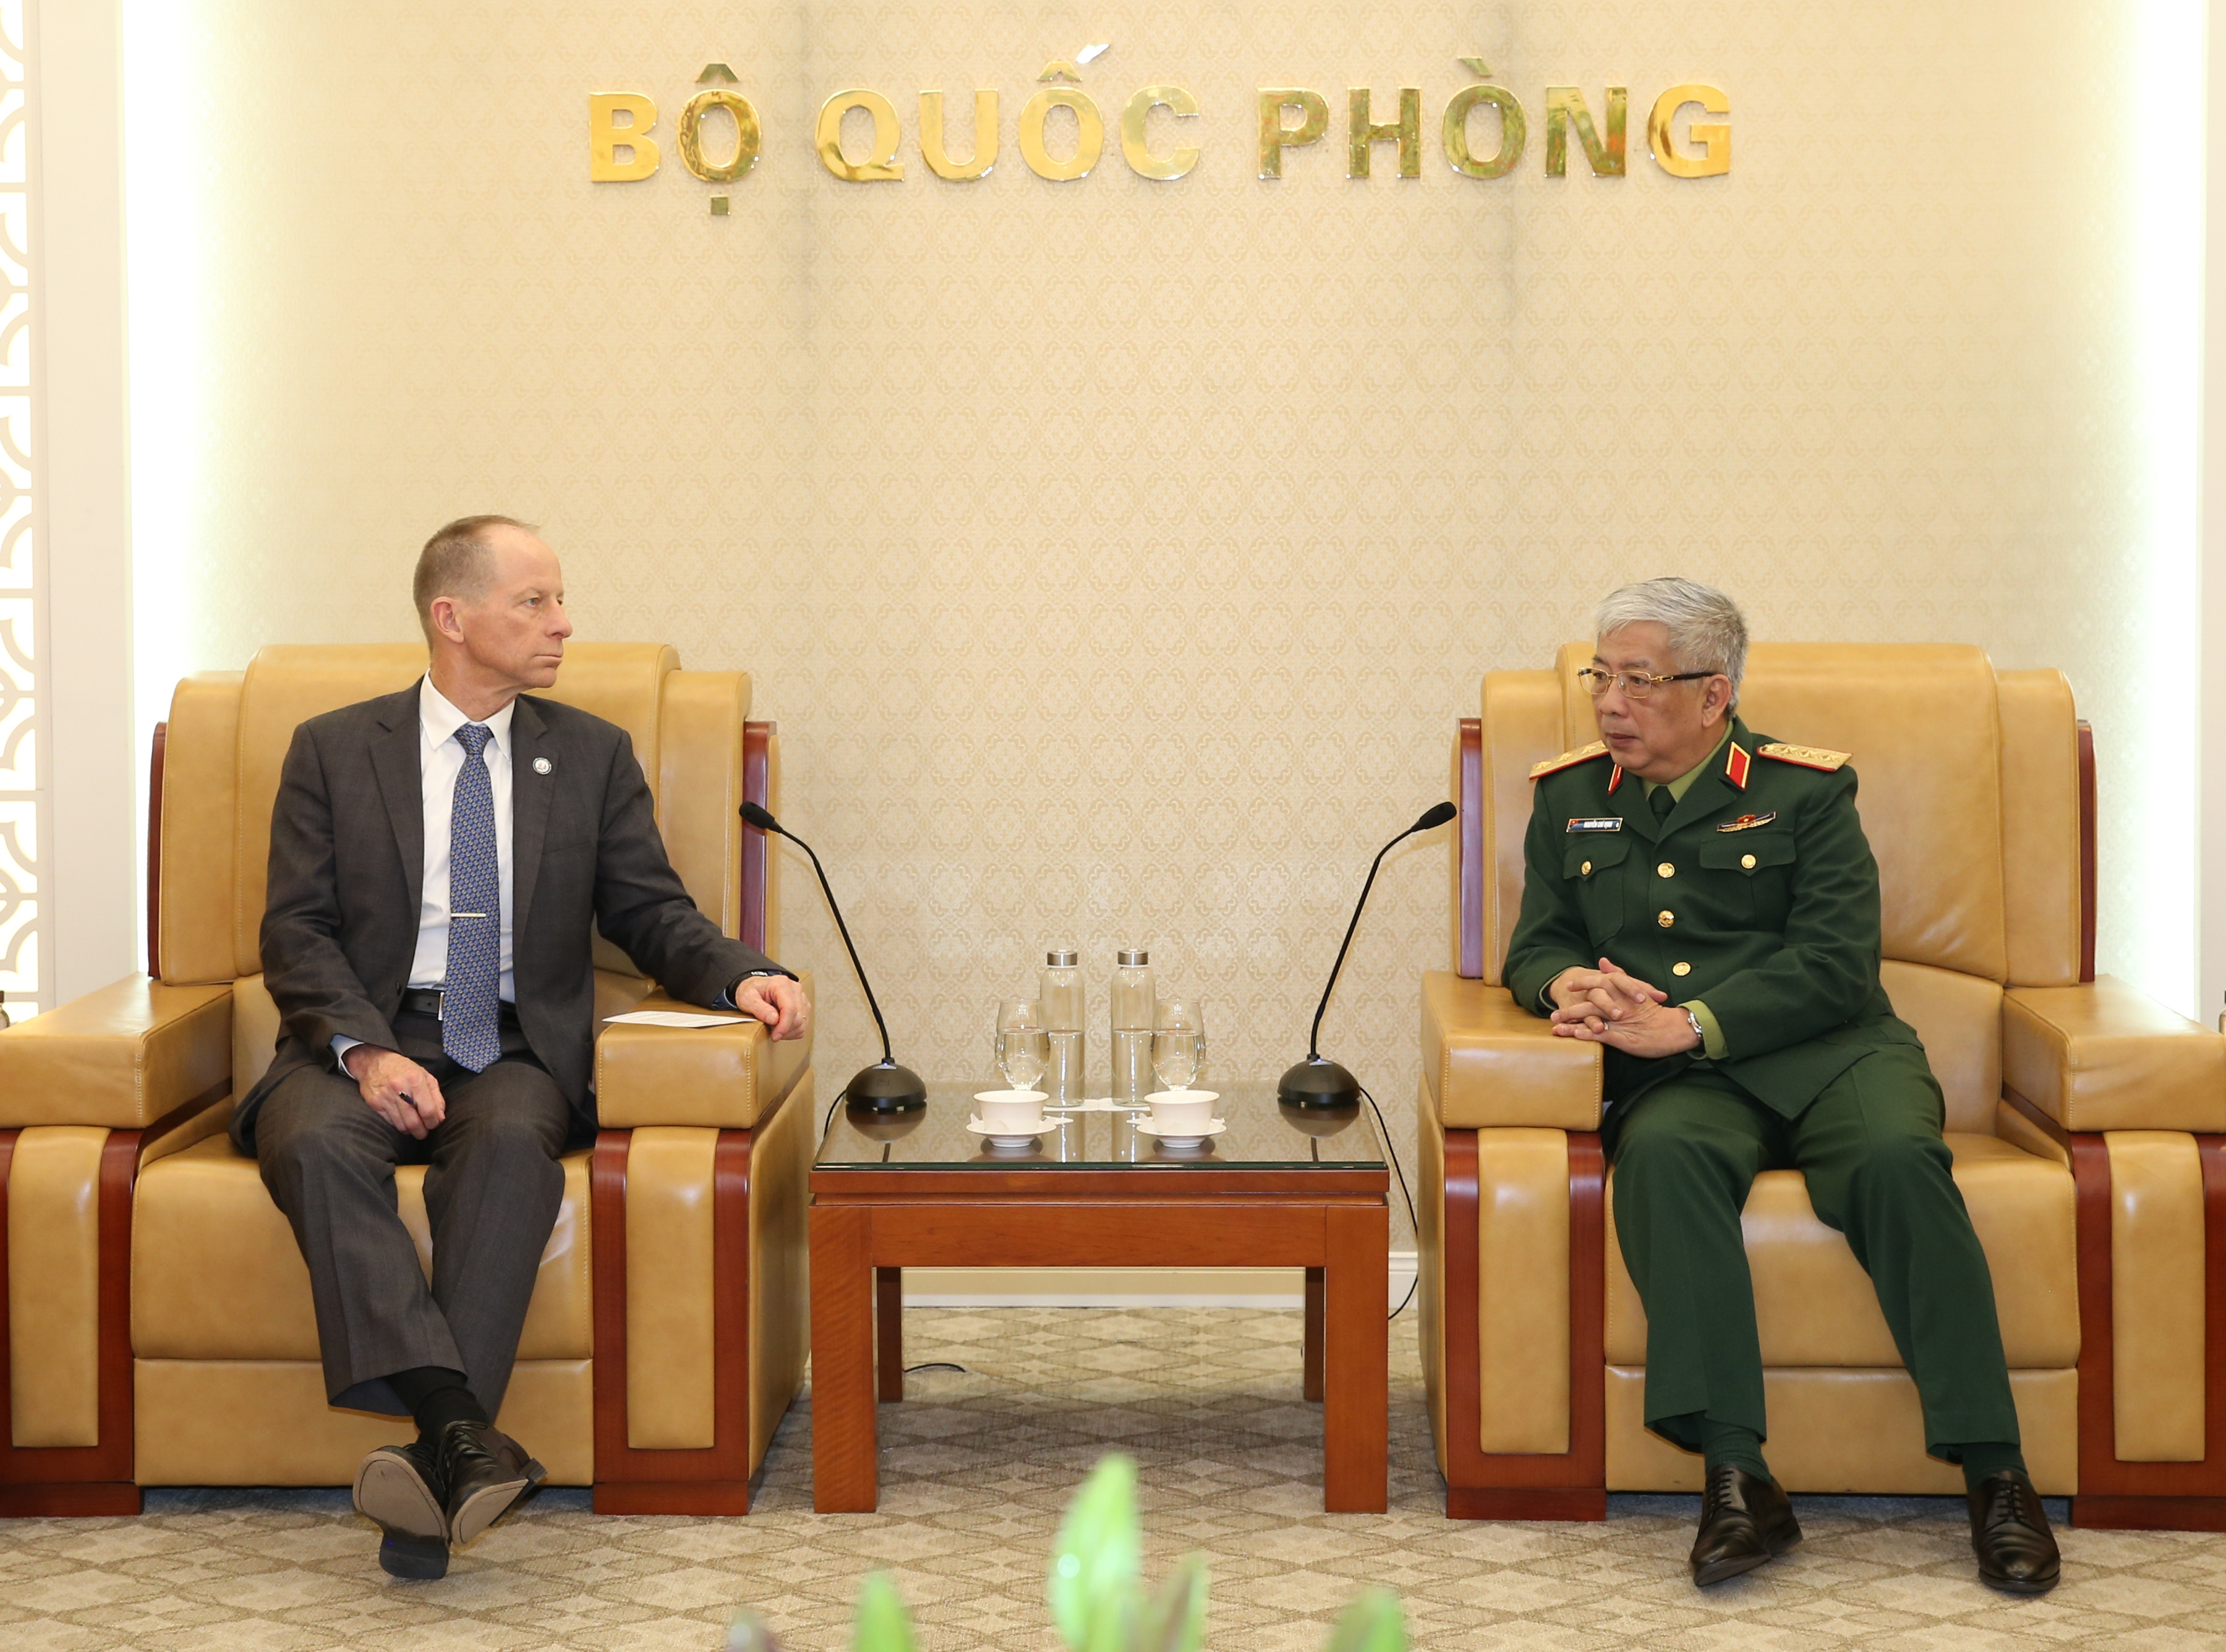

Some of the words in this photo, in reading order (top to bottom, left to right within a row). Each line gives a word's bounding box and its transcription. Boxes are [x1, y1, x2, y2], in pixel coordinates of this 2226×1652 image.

[589, 62, 761, 216] BỘ
[815, 43, 1200, 182] QUỐC
[1256, 56, 1731, 179] PHÒNG
